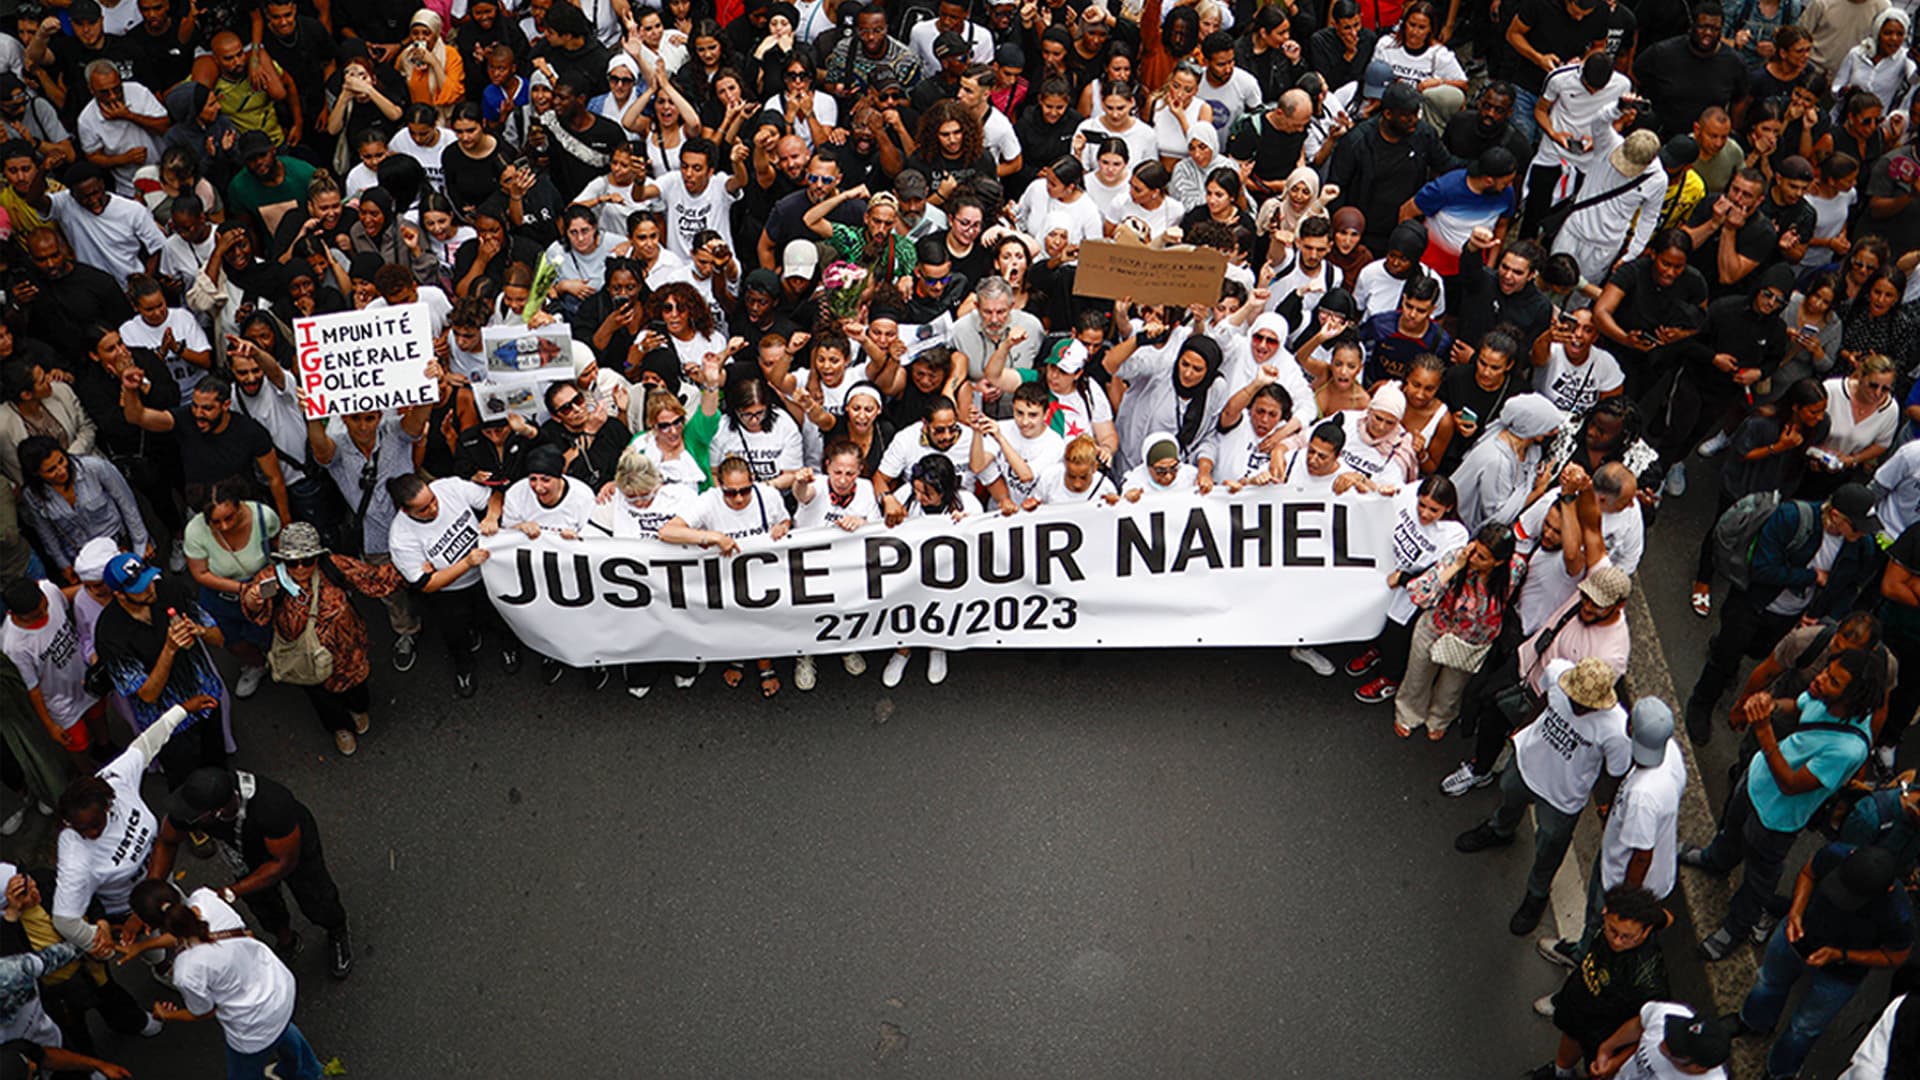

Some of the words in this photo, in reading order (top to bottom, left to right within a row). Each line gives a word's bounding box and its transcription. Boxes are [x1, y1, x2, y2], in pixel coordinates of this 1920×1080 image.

[305, 368, 385, 394] POLICE
[306, 384, 434, 417] NATIONALE
[427, 527, 454, 558] JUSTICE
[498, 544, 835, 609] JUSTICE
[865, 523, 1085, 600] POUR
[1117, 504, 1375, 577] NAHEL
[815, 595, 1078, 641] 27/06/2023
[111, 808, 141, 867] JUSTICE
[130, 827, 149, 863] POUR
